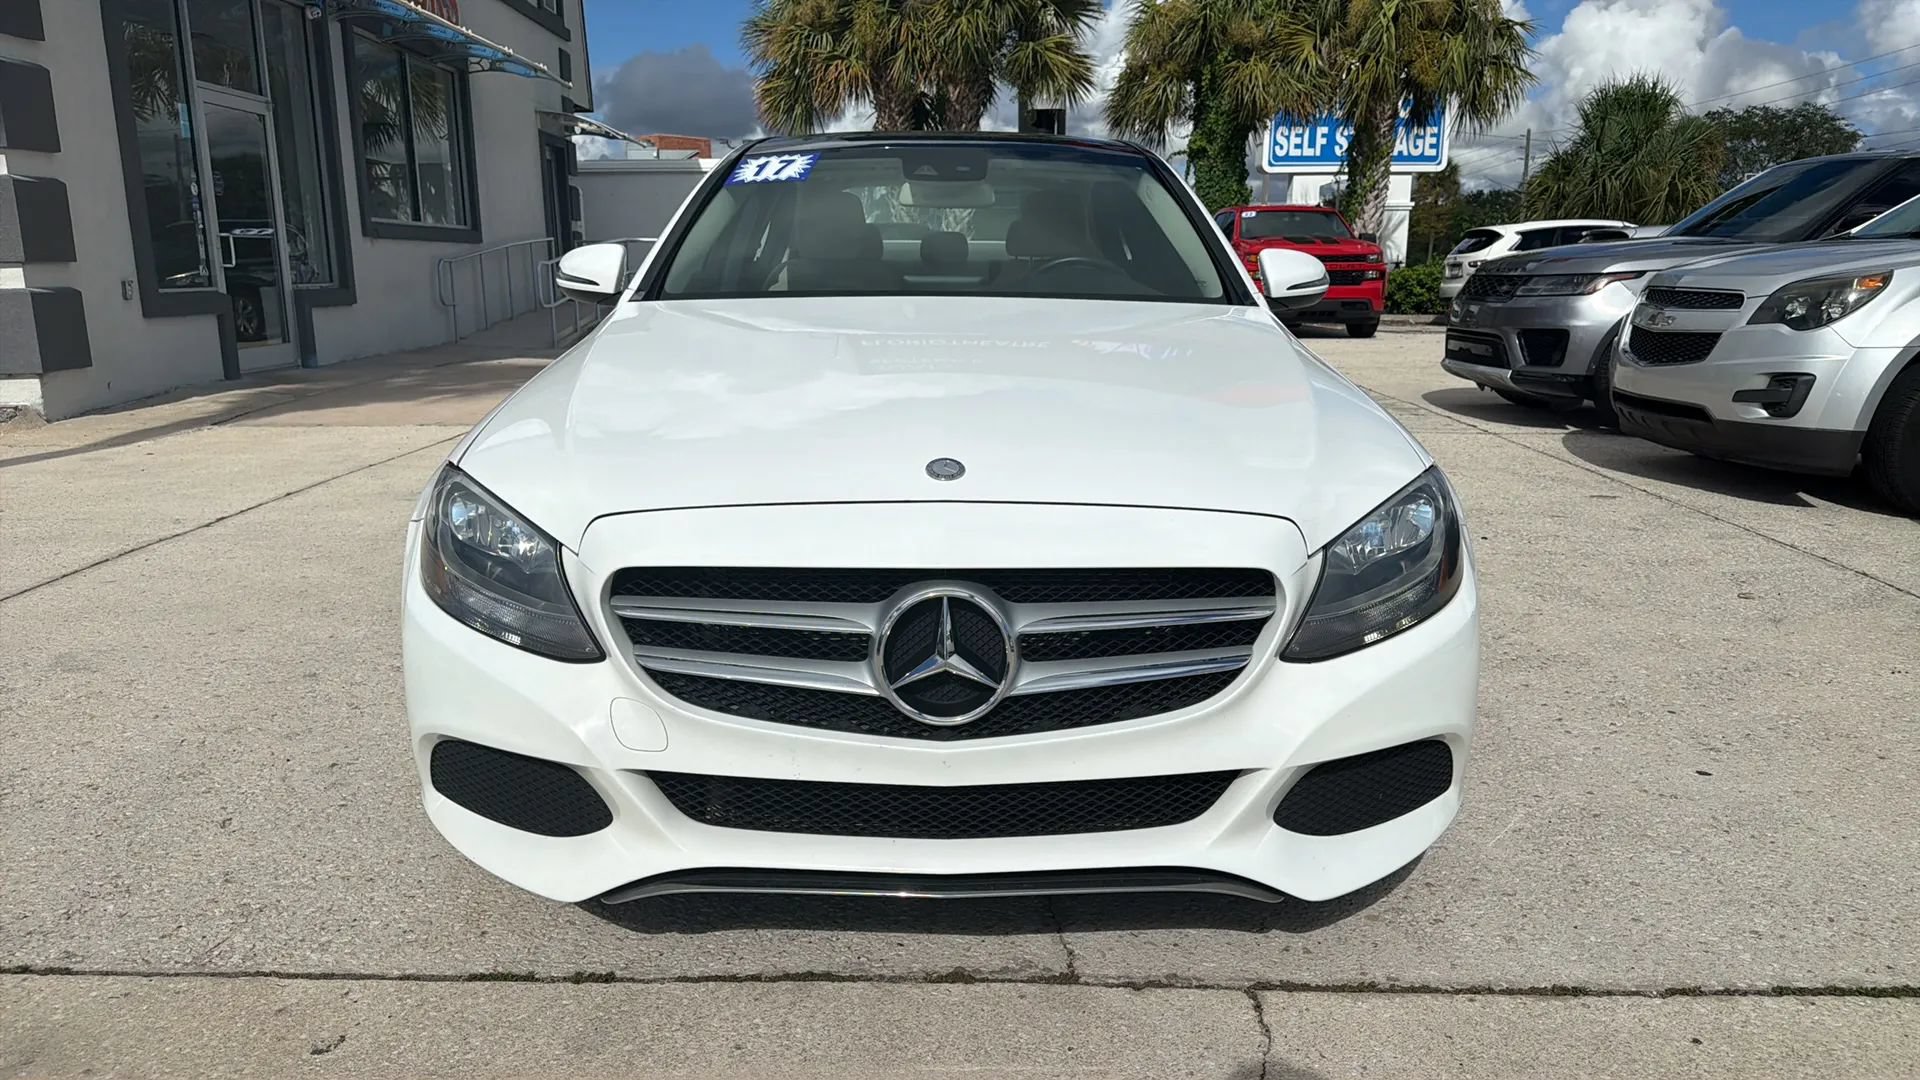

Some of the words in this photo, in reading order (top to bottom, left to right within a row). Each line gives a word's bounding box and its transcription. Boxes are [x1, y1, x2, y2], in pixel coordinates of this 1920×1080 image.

[1274, 126, 1329, 157] SELF
[1334, 126, 1438, 157] SAGE
[752, 159, 797, 177] 17
